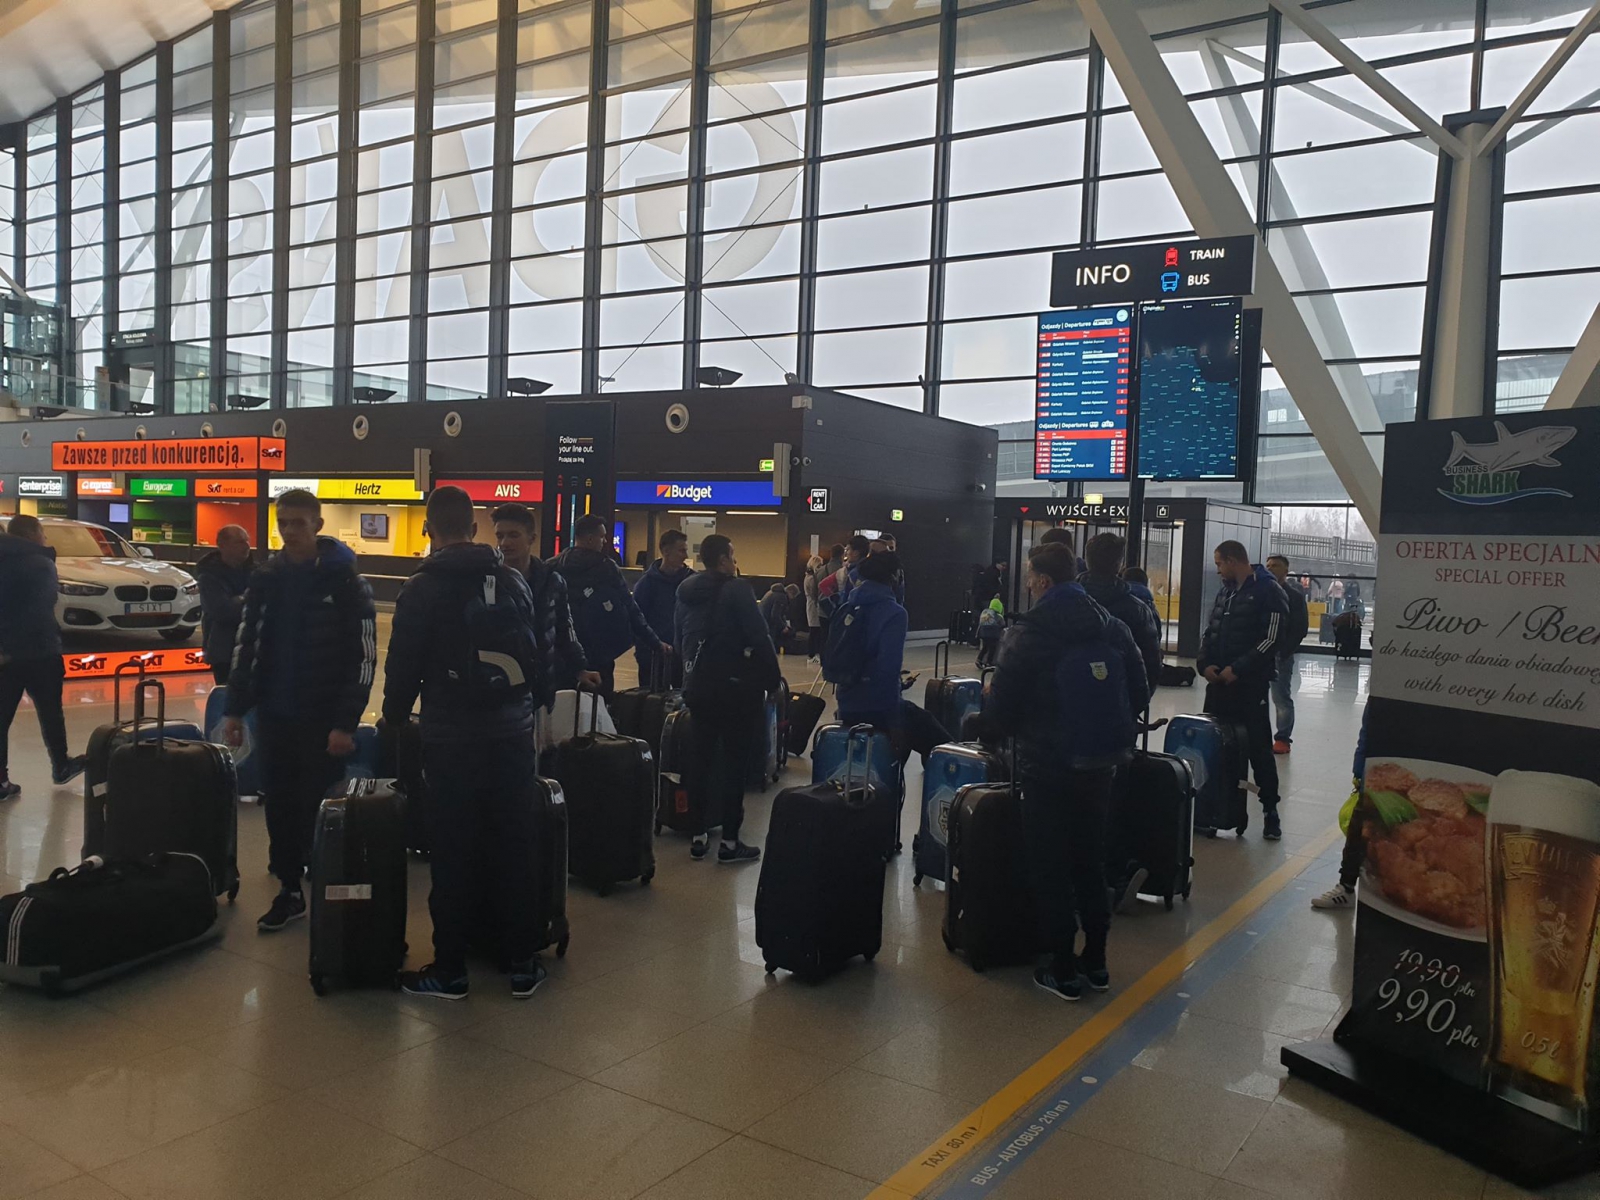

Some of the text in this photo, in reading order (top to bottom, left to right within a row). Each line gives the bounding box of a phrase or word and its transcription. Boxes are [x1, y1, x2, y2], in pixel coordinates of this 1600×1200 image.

[1190, 248, 1224, 260] TRAIN
[1076, 264, 1130, 286] INFO
[1188, 274, 1210, 286] BUS
[63, 441, 244, 468] Zawsze przed konkurencją.
[262, 448, 282, 458] SIXT
[1446, 465, 1488, 474] BUSINESS
[22, 480, 60, 493] enterprise
[143, 481, 173, 493] Europcar
[207, 483, 222, 493] SIXT
[355, 483, 381, 495] Hertz
[495, 485, 520, 497] AVIS
[672, 484, 712, 499] Budget
[1454, 471, 1518, 494] SHARK
[1046, 504, 1129, 516] WYJŚCIE EXI
[1396, 540, 1477, 561] OFERTA
[1435, 568, 1566, 588] SPECIAL OFFER
[1396, 597, 1488, 635] Piwo
[69, 655, 107, 672] SIXT
[1380, 640, 1396, 656] do
[1400, 641, 1463, 667] każdego
[1466, 648, 1512, 669] dania
[1404, 676, 1587, 712] with every hot dish
[1395, 949, 1476, 997] 19,90 pln
[1377, 978, 1480, 1048] 9,90 pln
[921, 1130, 974, 1168] TAXI 80 m
[971, 1165, 999, 1186] BUS
[1000, 1124, 1044, 1162] AUTOBUS
[1038, 1110, 1060, 1125] 210
[1055, 1103, 1068, 1113] m
